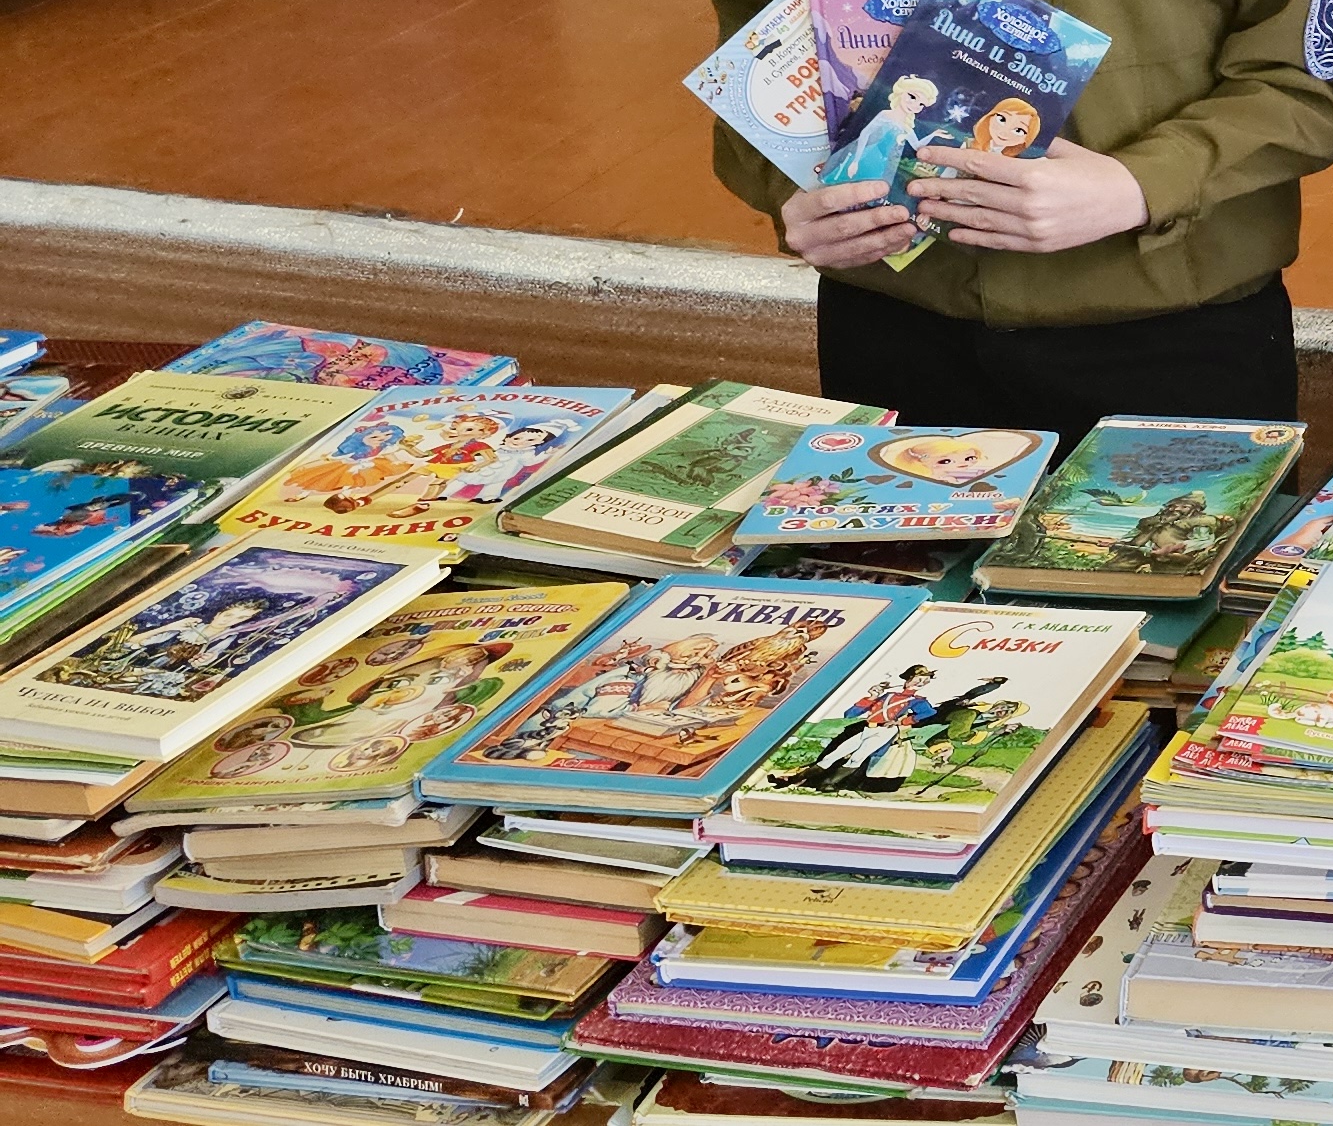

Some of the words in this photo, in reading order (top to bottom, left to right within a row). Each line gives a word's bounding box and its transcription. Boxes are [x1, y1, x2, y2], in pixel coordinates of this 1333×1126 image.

[838, 26, 893, 50] Анна
[993, 6, 1048, 43] ХОЛОДНОЕ
[999, 21, 1034, 43] СЕРДЦЕ
[933, 6, 984, 51] Анна
[988, 40, 1004, 63] и
[1008, 48, 1068, 99] Эльза
[951, 48, 989, 76] Магия
[988, 65, 1033, 96] памяти
[92, 402, 302, 435] ИСТОРИЯ
[374, 390, 604, 418] ПРИКЛЮЧЕНИЯ
[753, 395, 832, 417] ДАНИЭЛЬ
[759, 405, 813, 420] ДЕФО
[78, 440, 163, 455] ДРЕВНИЙ
[166, 447, 204, 459] МИР
[581, 490, 694, 522] РОБИНЗОН
[582, 502, 665, 527] КРУЗО
[766, 505, 789, 516] В
[797, 503, 918, 515] ГОСТЯХ
[235, 508, 474, 538] БУРАТИНО
[780, 514, 1002, 531] ЗОЛУШКИ
[661, 593, 847, 629] БУКВАРЬ
[929, 620, 1064, 658] Сказки
[1039, 622, 1114, 634] АНДЕРСЕН
[18, 686, 80, 705] ЧУДЕСА
[85, 698, 111, 709] НА
[113, 702, 176, 718] ВЫБОР
[304, 1062, 337, 1076] ХОЧУ
[340, 1067, 375, 1082] БЫТЬ
[378, 1073, 443, 1093] ХРАБРЫМ!
